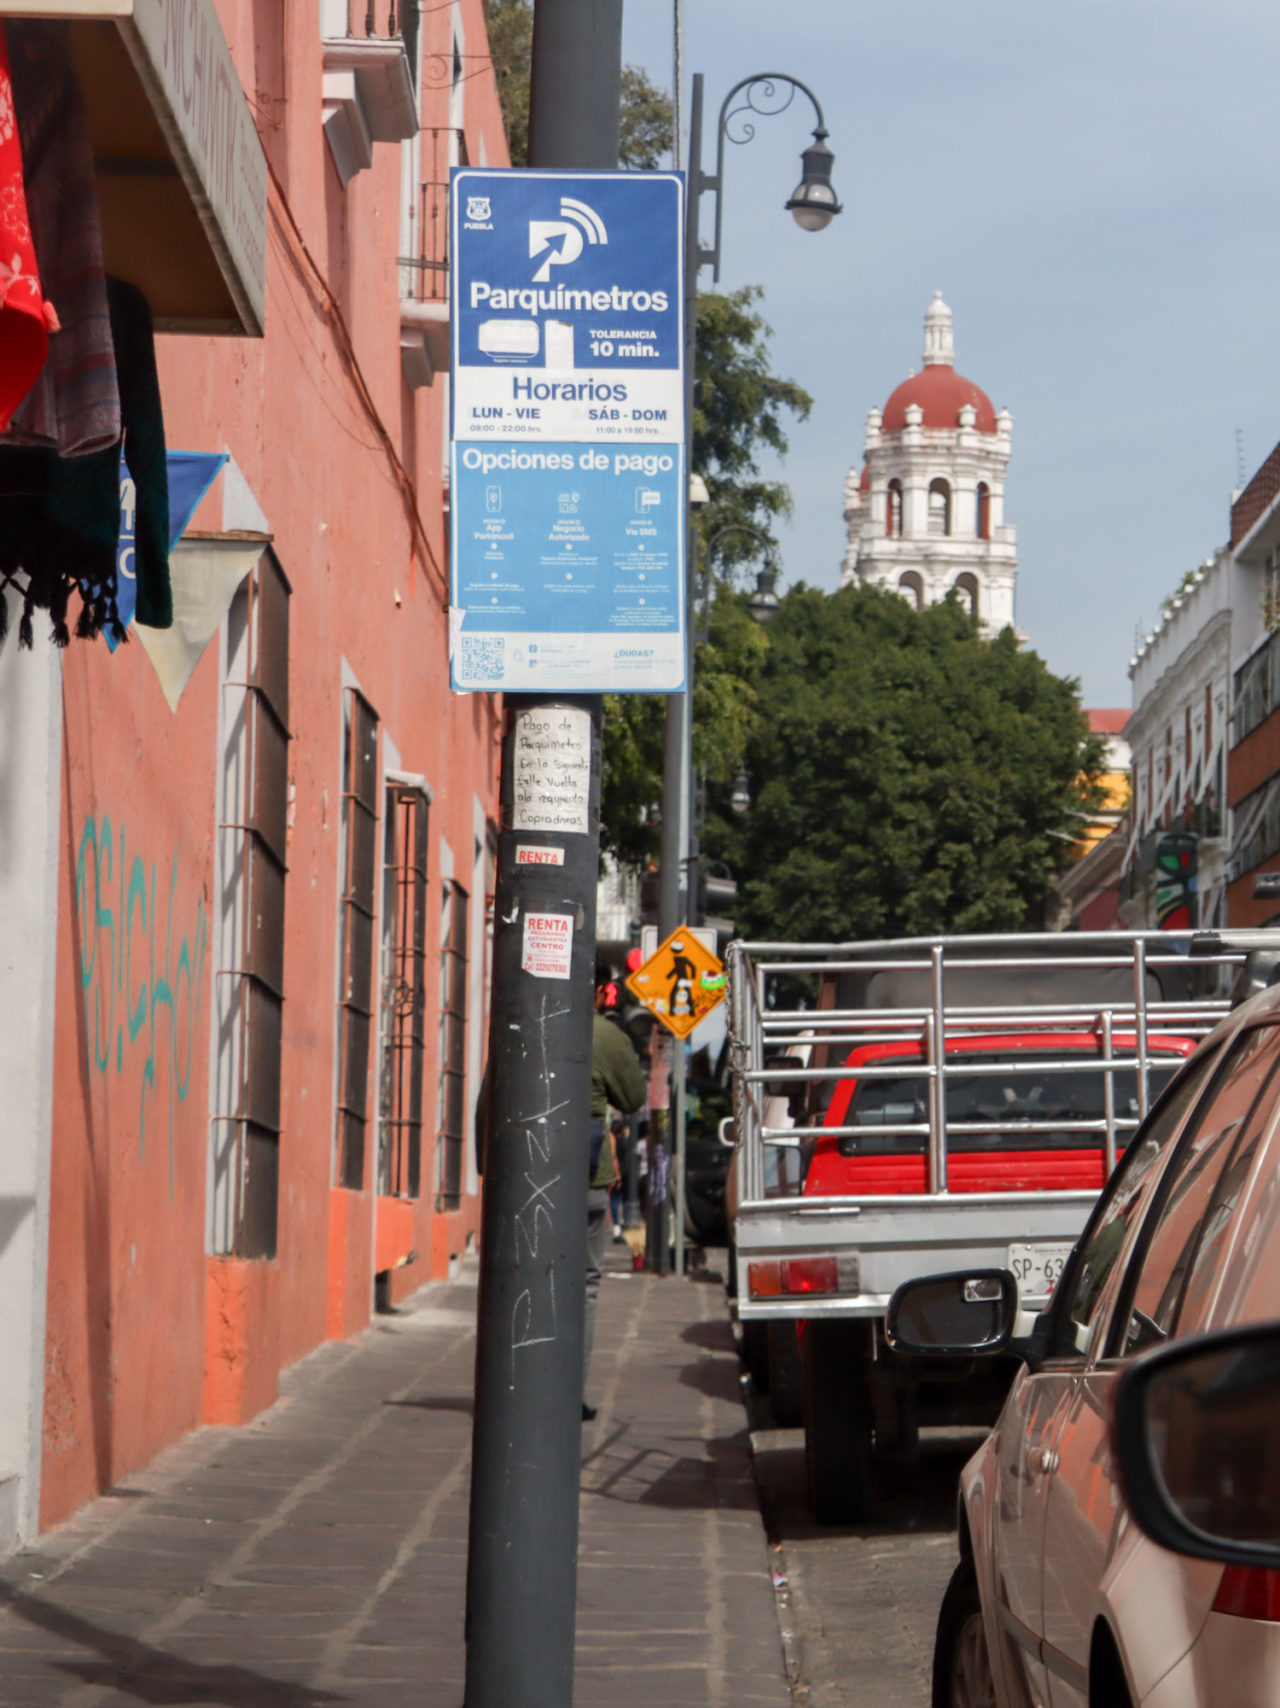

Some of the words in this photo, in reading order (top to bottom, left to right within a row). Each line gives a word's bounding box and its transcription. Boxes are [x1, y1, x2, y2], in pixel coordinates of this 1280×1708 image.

[470, 282, 669, 316] Parquímetros
[590, 329, 657, 340] TOLERANCIA
[590, 341, 614, 357] 10
[618, 342, 660, 357] min.
[513, 377, 628, 401] Horarios
[472, 407, 503, 418] LUN
[515, 408, 541, 419] VIE
[588, 405, 620, 420] SÁB
[632, 410, 667, 420] DOM
[463, 448, 574, 474] Opciones
[579, 450, 610, 470] de
[614, 455, 674, 476] pago
[553, 524, 585, 534] Negocio
[548, 533, 590, 541] Autorizado
[520, 712, 550, 734] Pago
[519, 850, 559, 864] RENTA
[528, 918, 568, 931] RENTA
[530, 942, 564, 950] CENTRO
